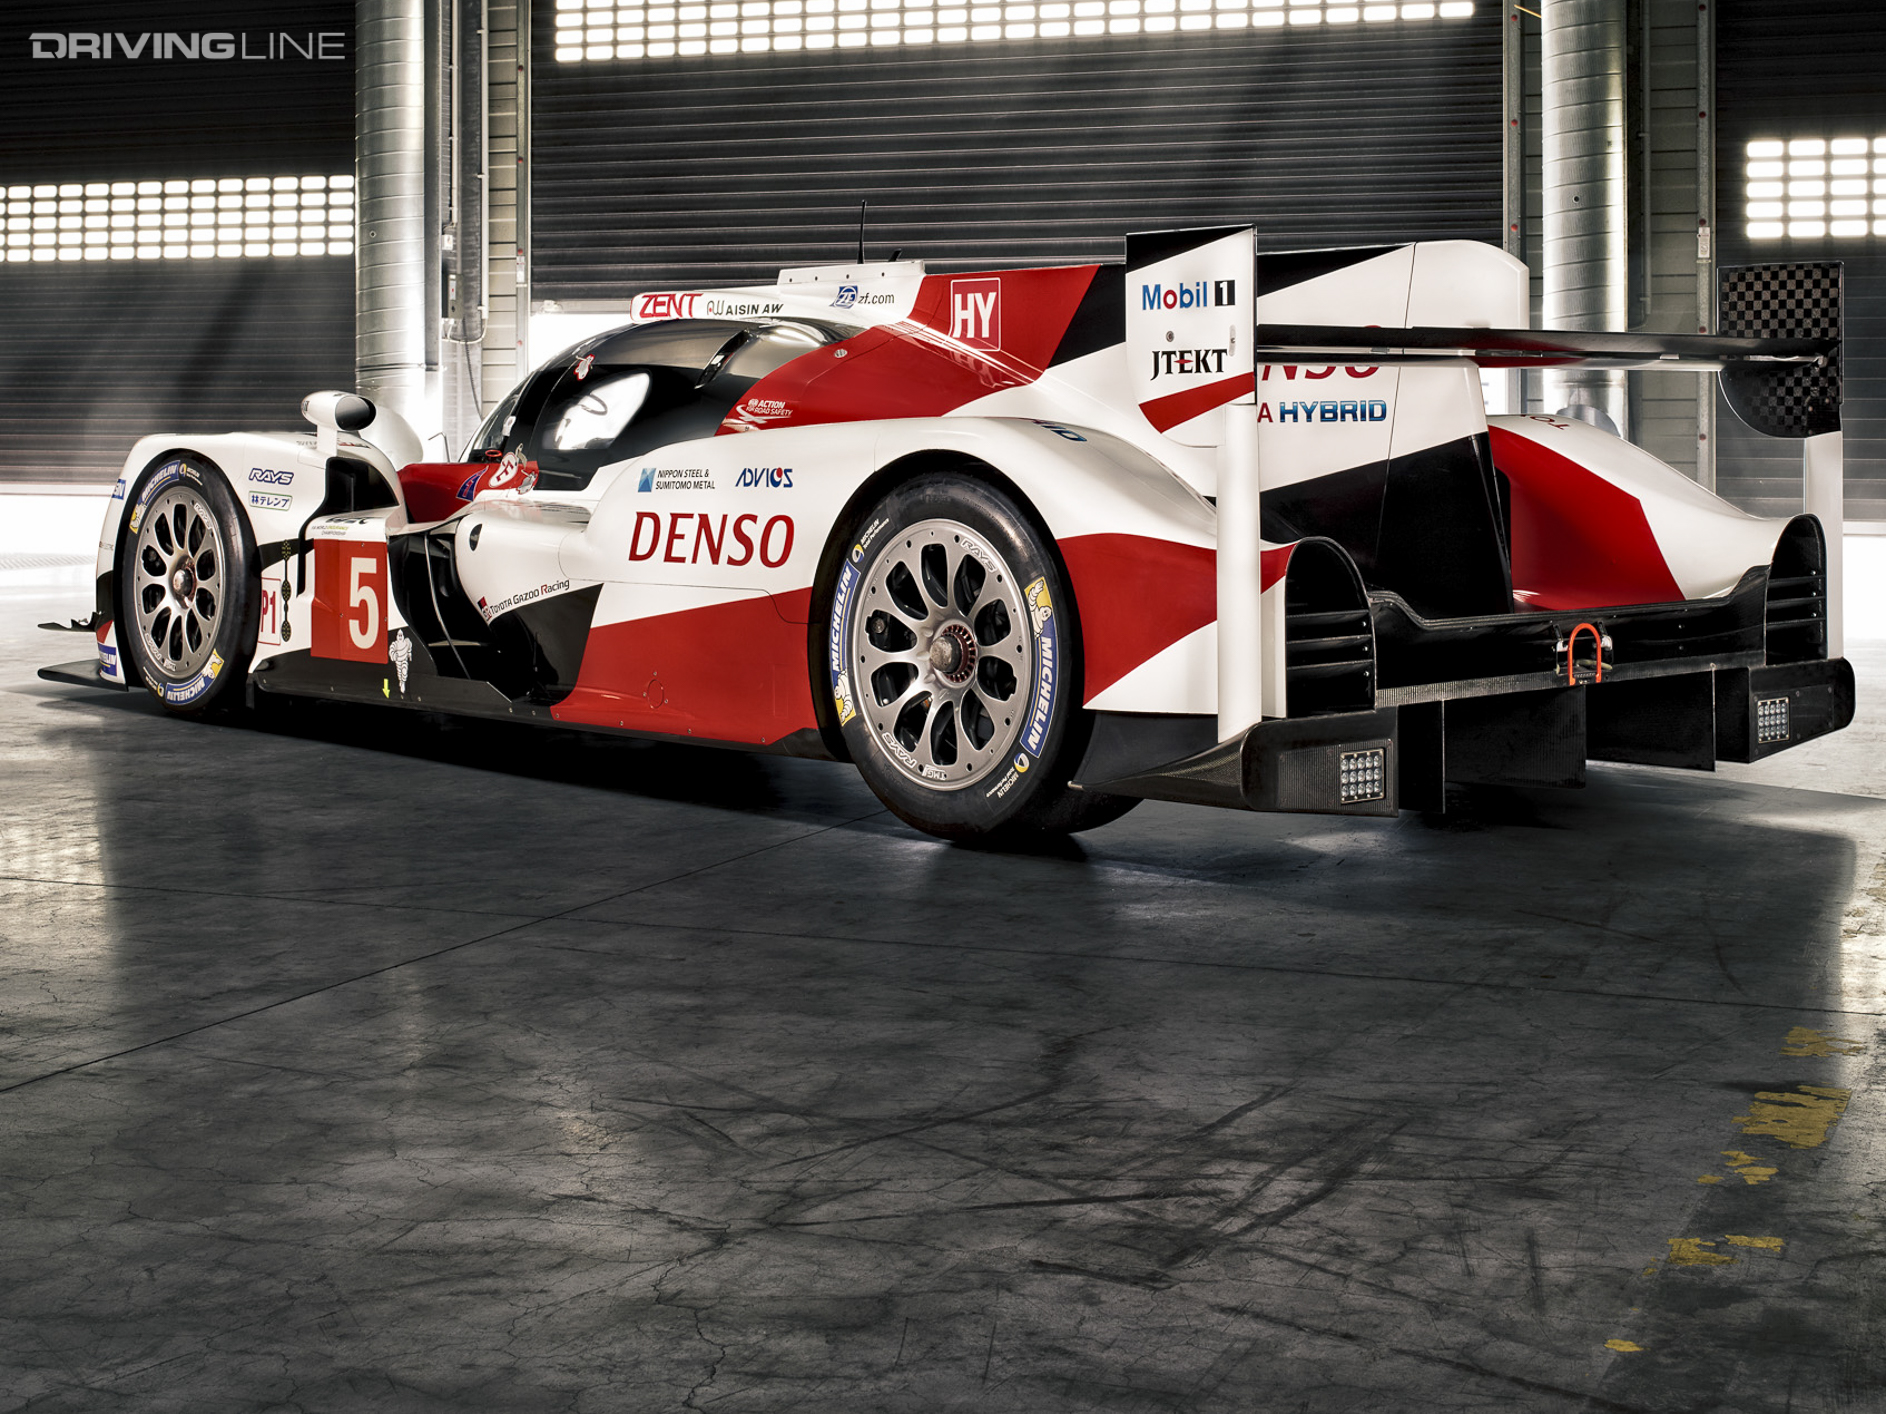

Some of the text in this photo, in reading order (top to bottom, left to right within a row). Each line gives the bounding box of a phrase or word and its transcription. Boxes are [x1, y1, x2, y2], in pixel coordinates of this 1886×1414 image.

[638, 292, 704, 319] ZENT
[725, 304, 760, 316] AISIN
[761, 302, 785, 315] AW
[857, 292, 895, 305] zf.com
[1142, 281, 1231, 311] Mobil 1
[952, 291, 997, 339] HY
[1150, 348, 1228, 381] JTEKT
[758, 400, 786, 409] ACTION
[770, 408, 794, 416] SAFETY
[1279, 399, 1388, 423] HYBRID
[141, 463, 178, 502] MICHELIN
[248, 467, 295, 485] RAYS
[655, 480, 716, 490] SUMITOMO METAL
[657, 469, 710, 478] NIPPON STEEL &
[628, 511, 795, 568] DENSO
[960, 538, 998, 573] RAYS
[348, 556, 380, 650] 5
[489, 598, 513, 615] TOYOTA
[540, 579, 570, 596] Racing
[831, 565, 853, 672] MICHELIN
[166, 677, 206, 702] MICHELIN
[1028, 636, 1054, 751] MICHELIN
[882, 732, 918, 769] RAYS
